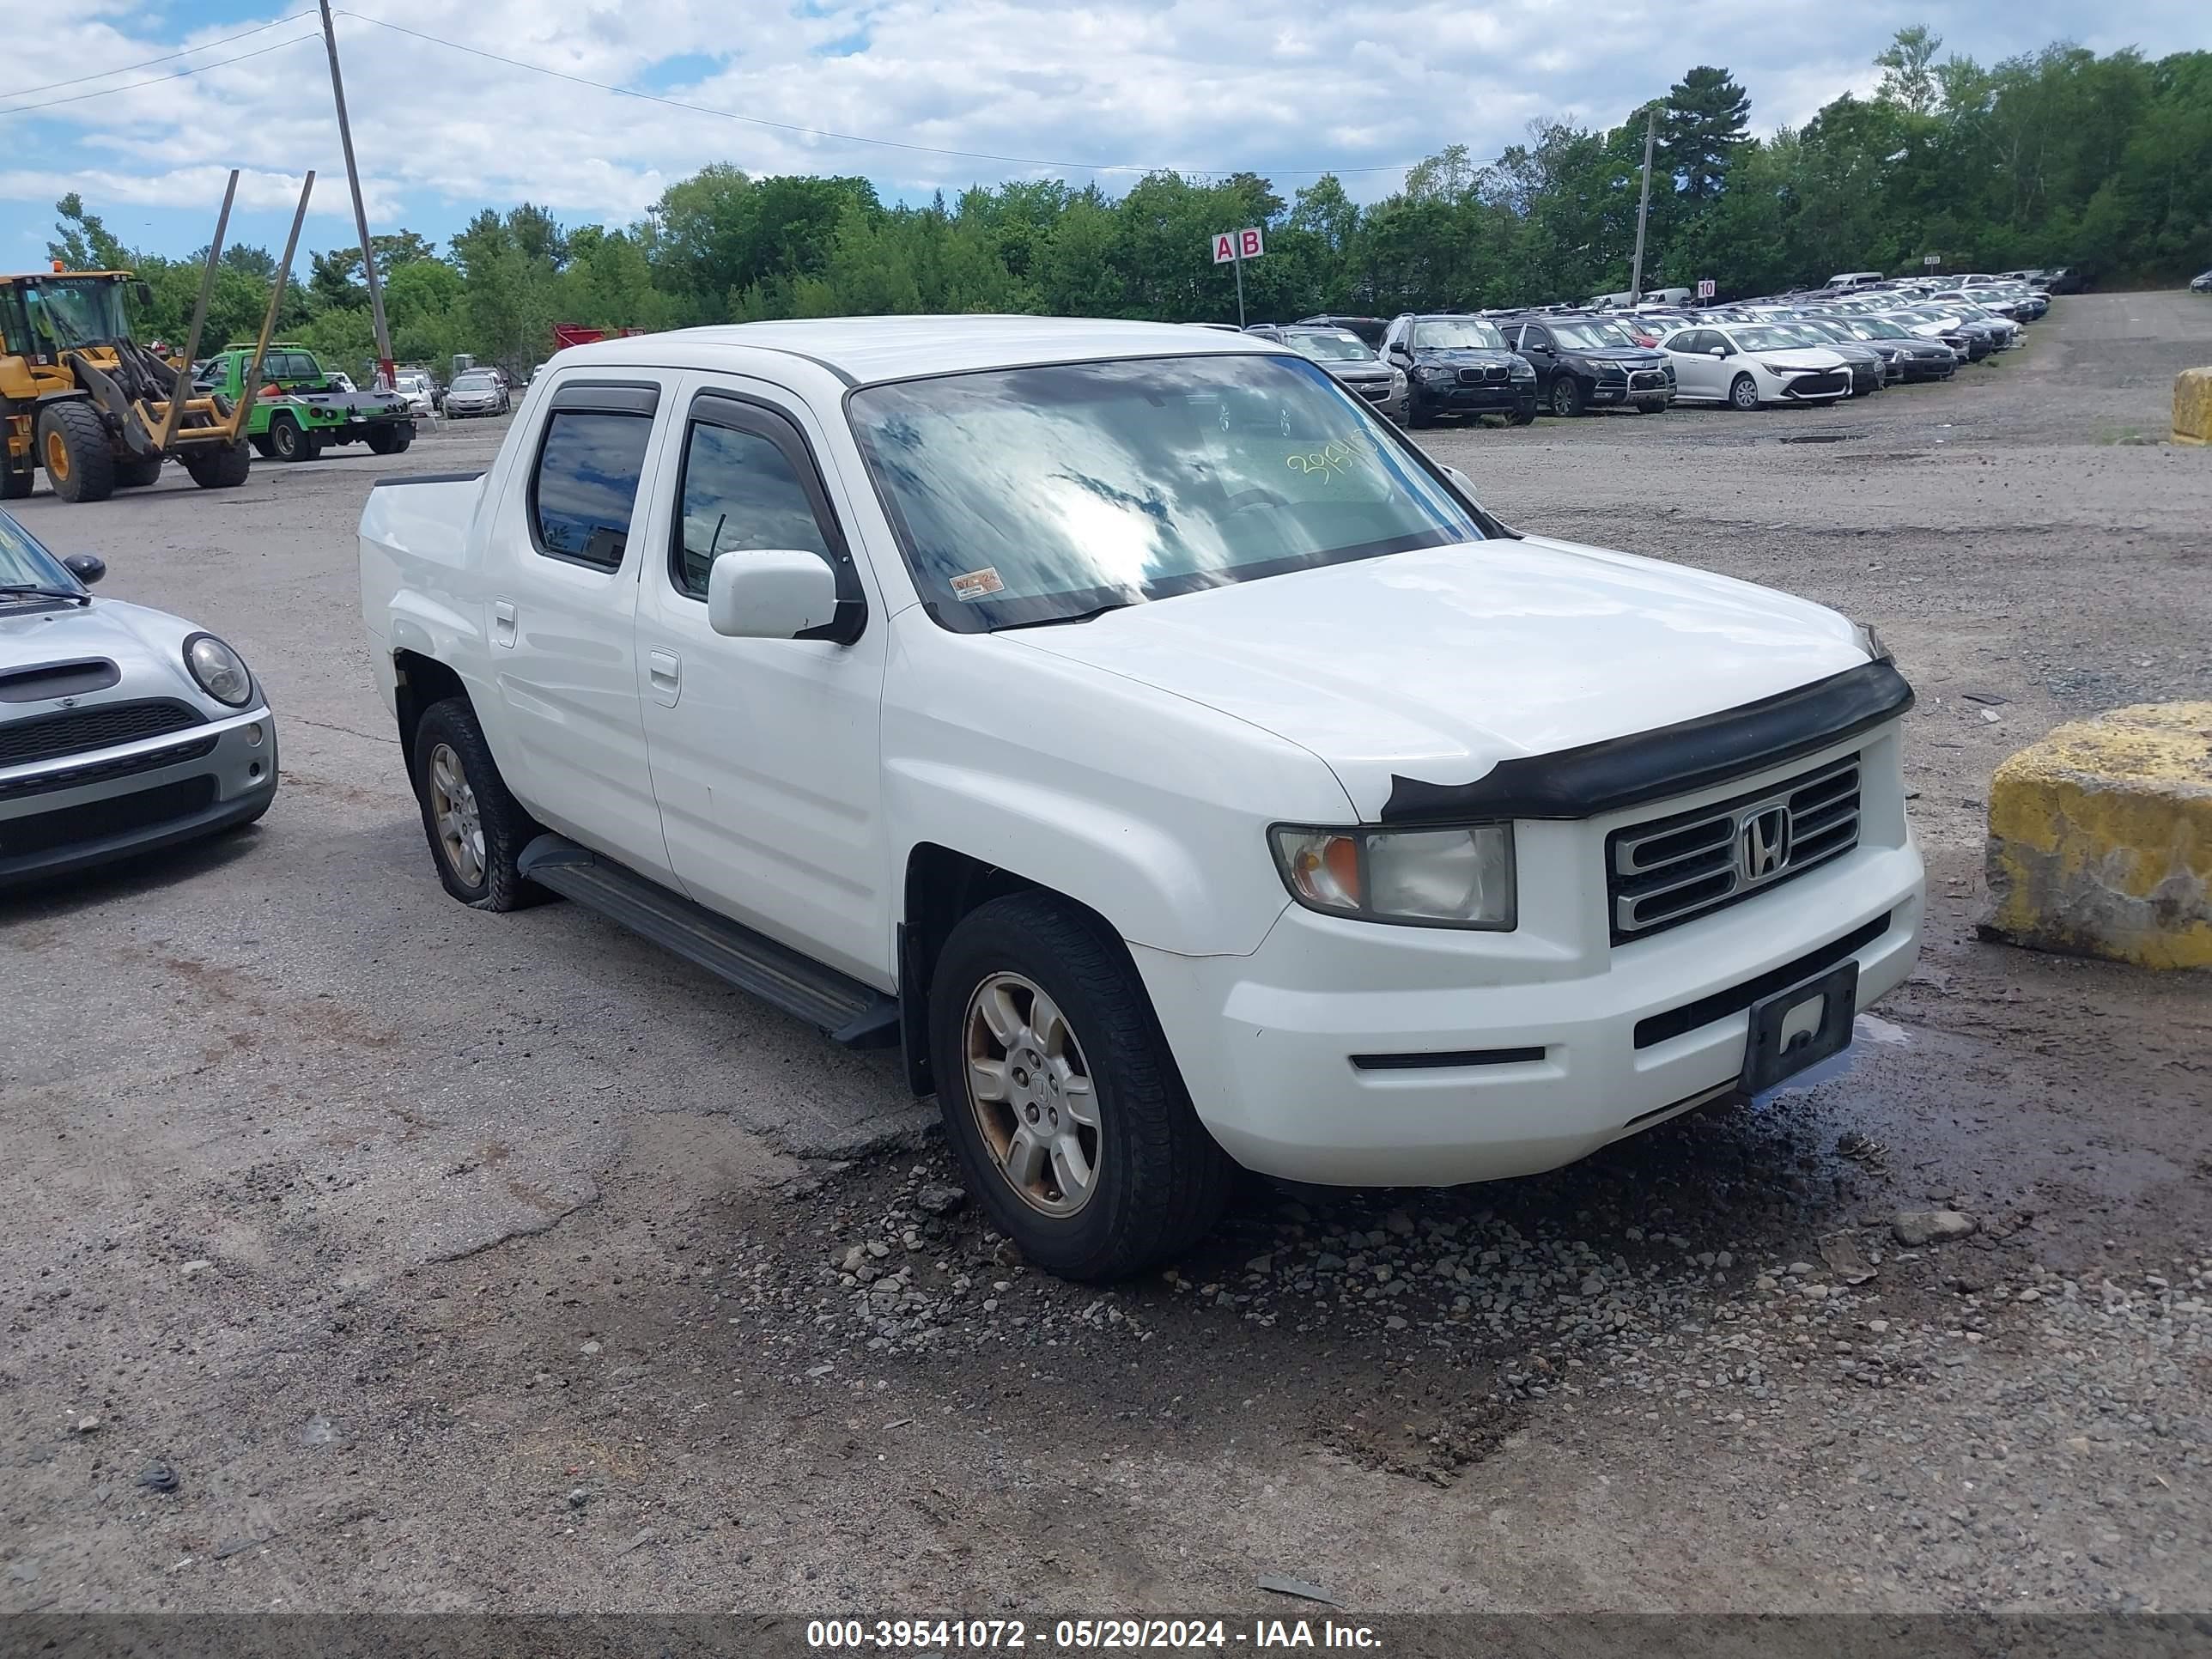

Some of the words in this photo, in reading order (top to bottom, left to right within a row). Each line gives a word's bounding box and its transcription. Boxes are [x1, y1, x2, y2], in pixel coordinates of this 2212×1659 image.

[1217, 236, 1234, 260] A
[1243, 231, 1260, 255] B
[1699, 282, 1713, 296] 10
